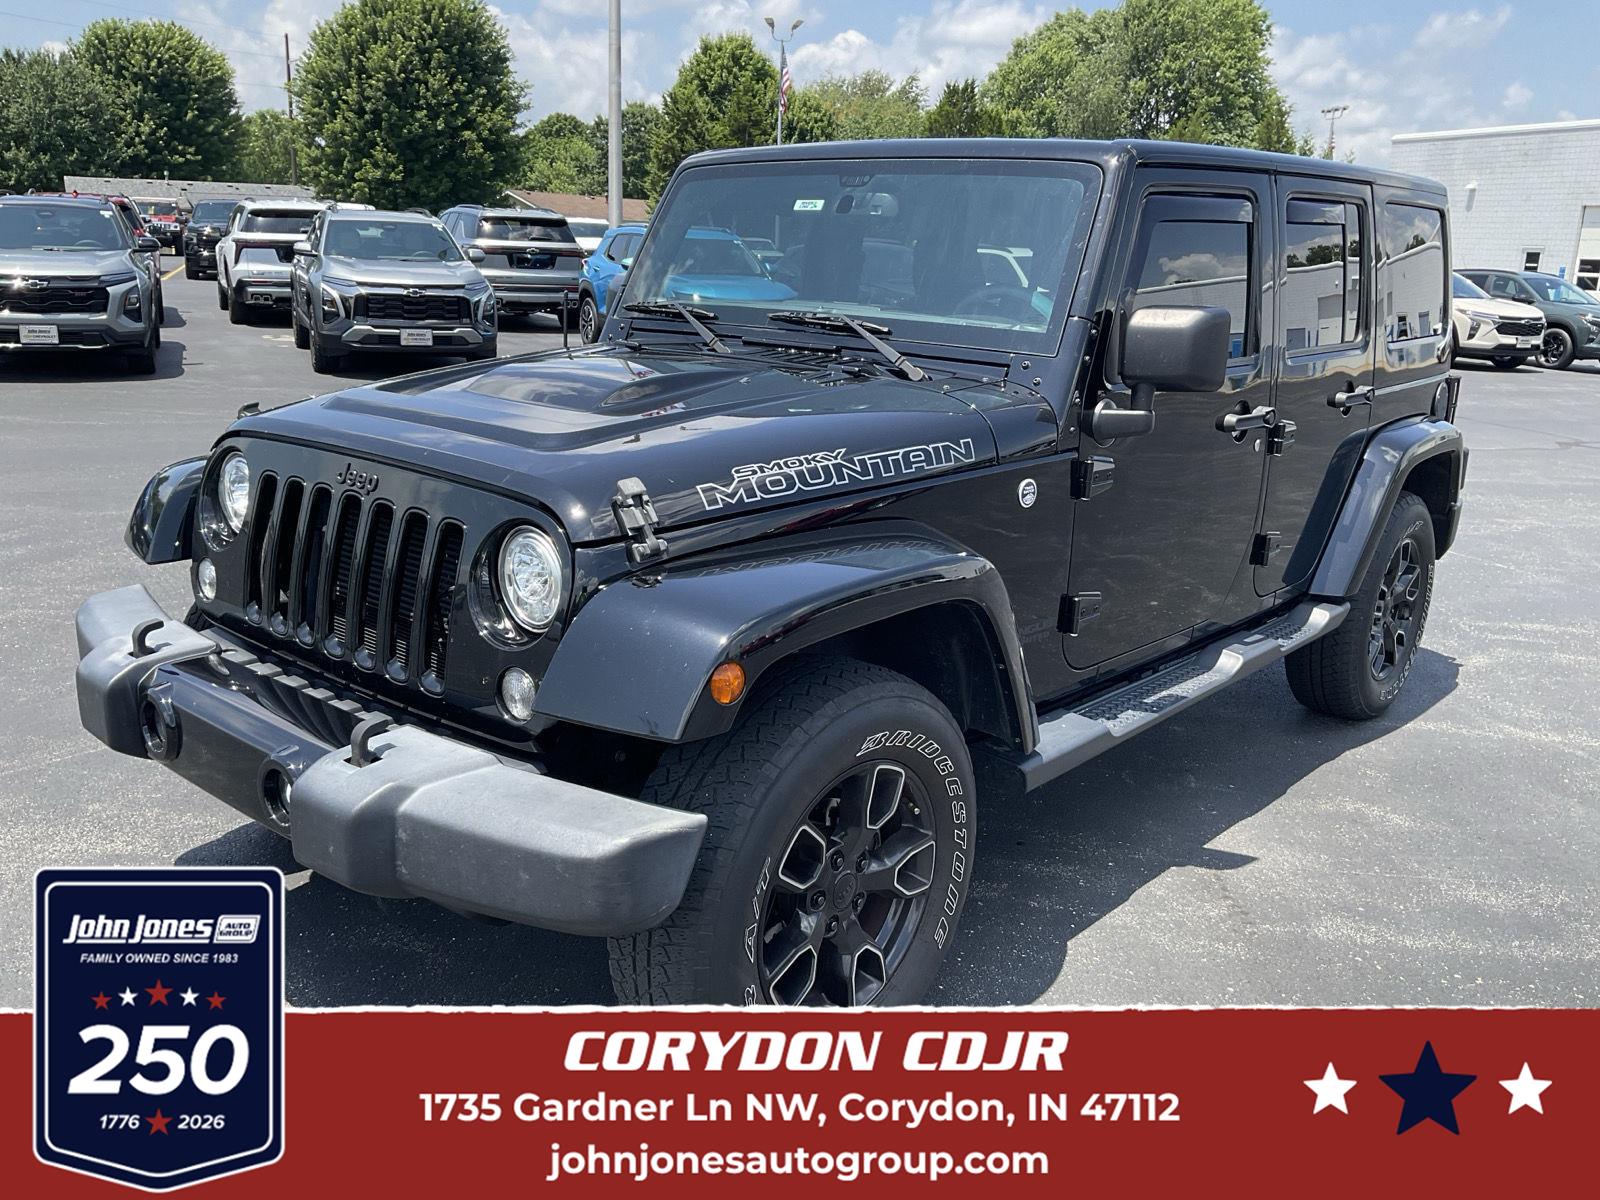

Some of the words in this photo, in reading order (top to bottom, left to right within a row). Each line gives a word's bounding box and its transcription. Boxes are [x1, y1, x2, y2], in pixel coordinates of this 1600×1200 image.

[335, 462, 380, 497] Jeep
[696, 438, 976, 510] MOUNTAIN
[732, 448, 847, 479] SMOKY
[856, 730, 967, 949] BRIDGESTONE
